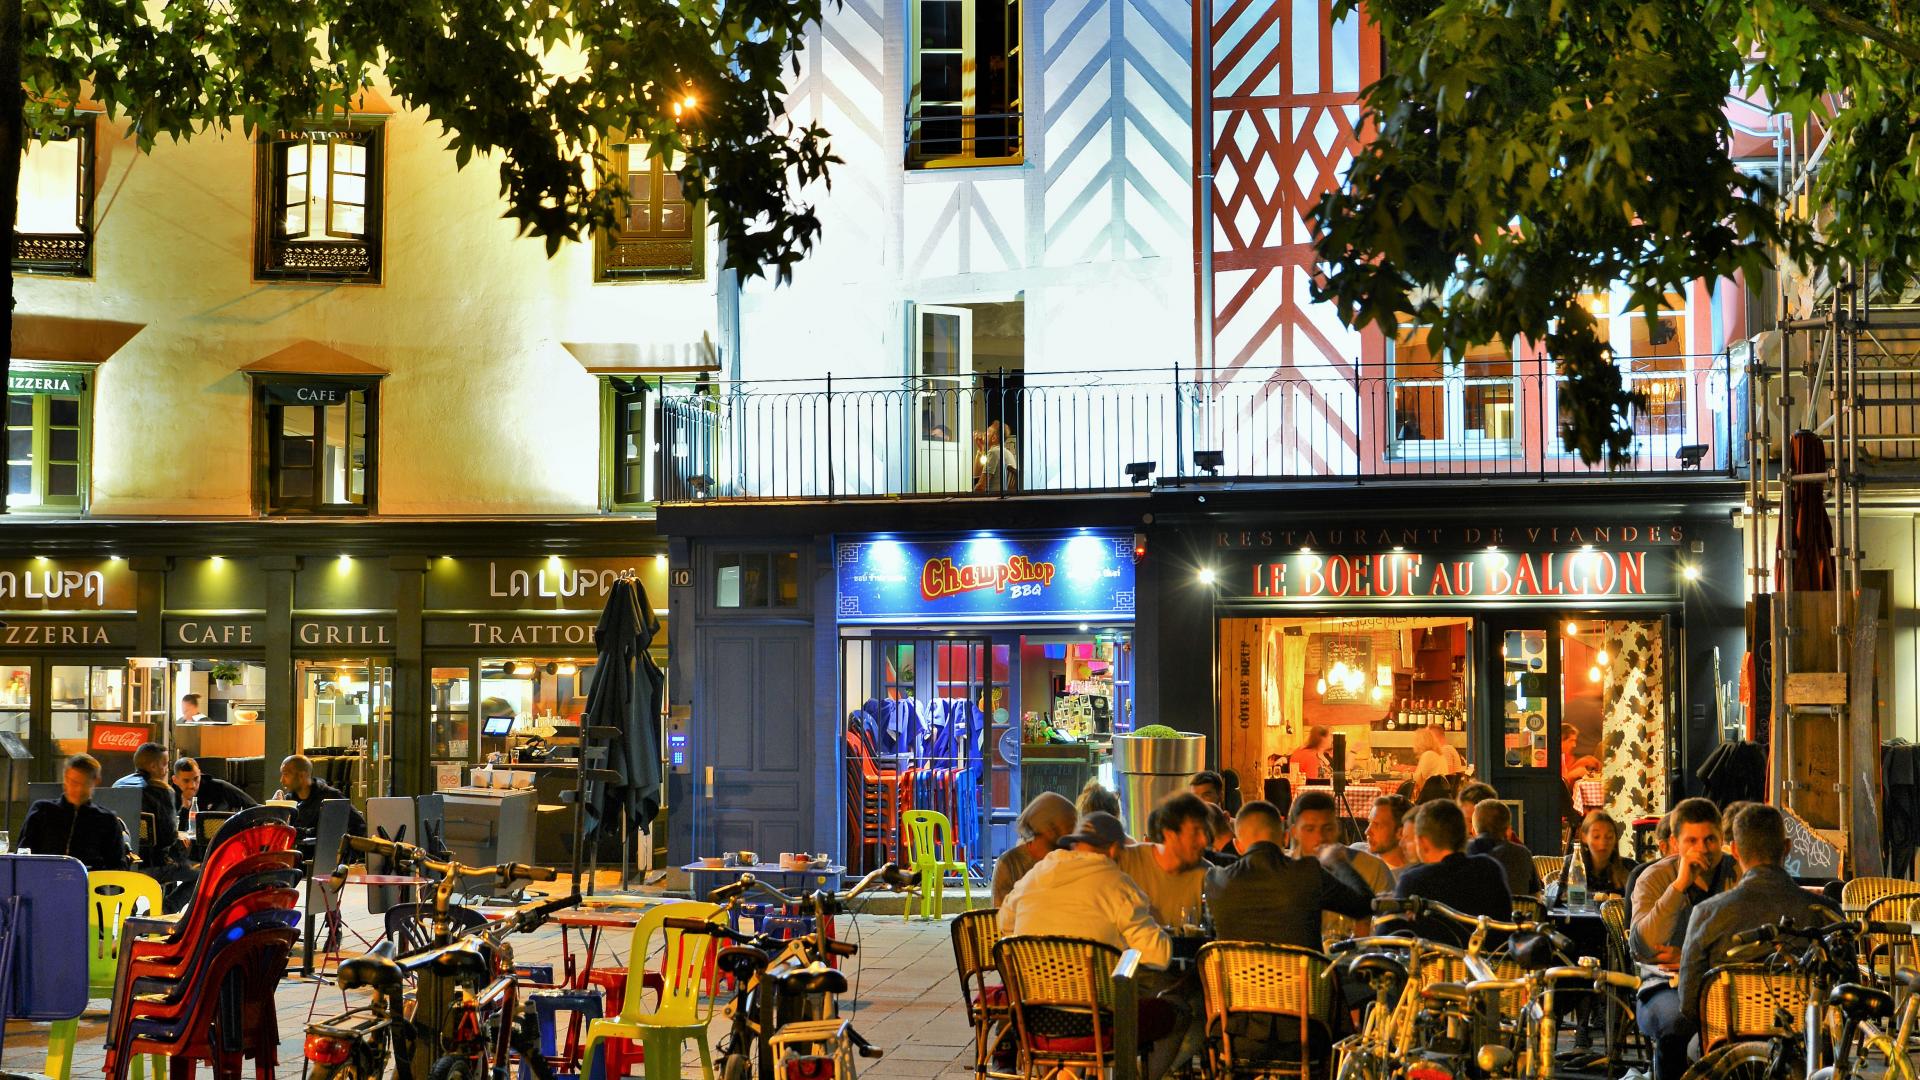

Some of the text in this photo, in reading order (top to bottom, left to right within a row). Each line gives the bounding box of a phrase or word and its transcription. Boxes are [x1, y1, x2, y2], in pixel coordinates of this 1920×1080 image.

[296, 387, 336, 401] CAFE
[1217, 525, 1684, 548] RESTAURANT DE VIANDES
[674, 571, 690, 585] 10
[1252, 562, 1288, 597] LE
[1427, 561, 1474, 596] AU
[1484, 551, 1648, 596] BALCON
[24, 570, 104, 607] LUPA
[1010, 583, 1043, 599] BBQ
[178, 622, 253, 645] CAFE
[299, 622, 391, 645] GRILL
